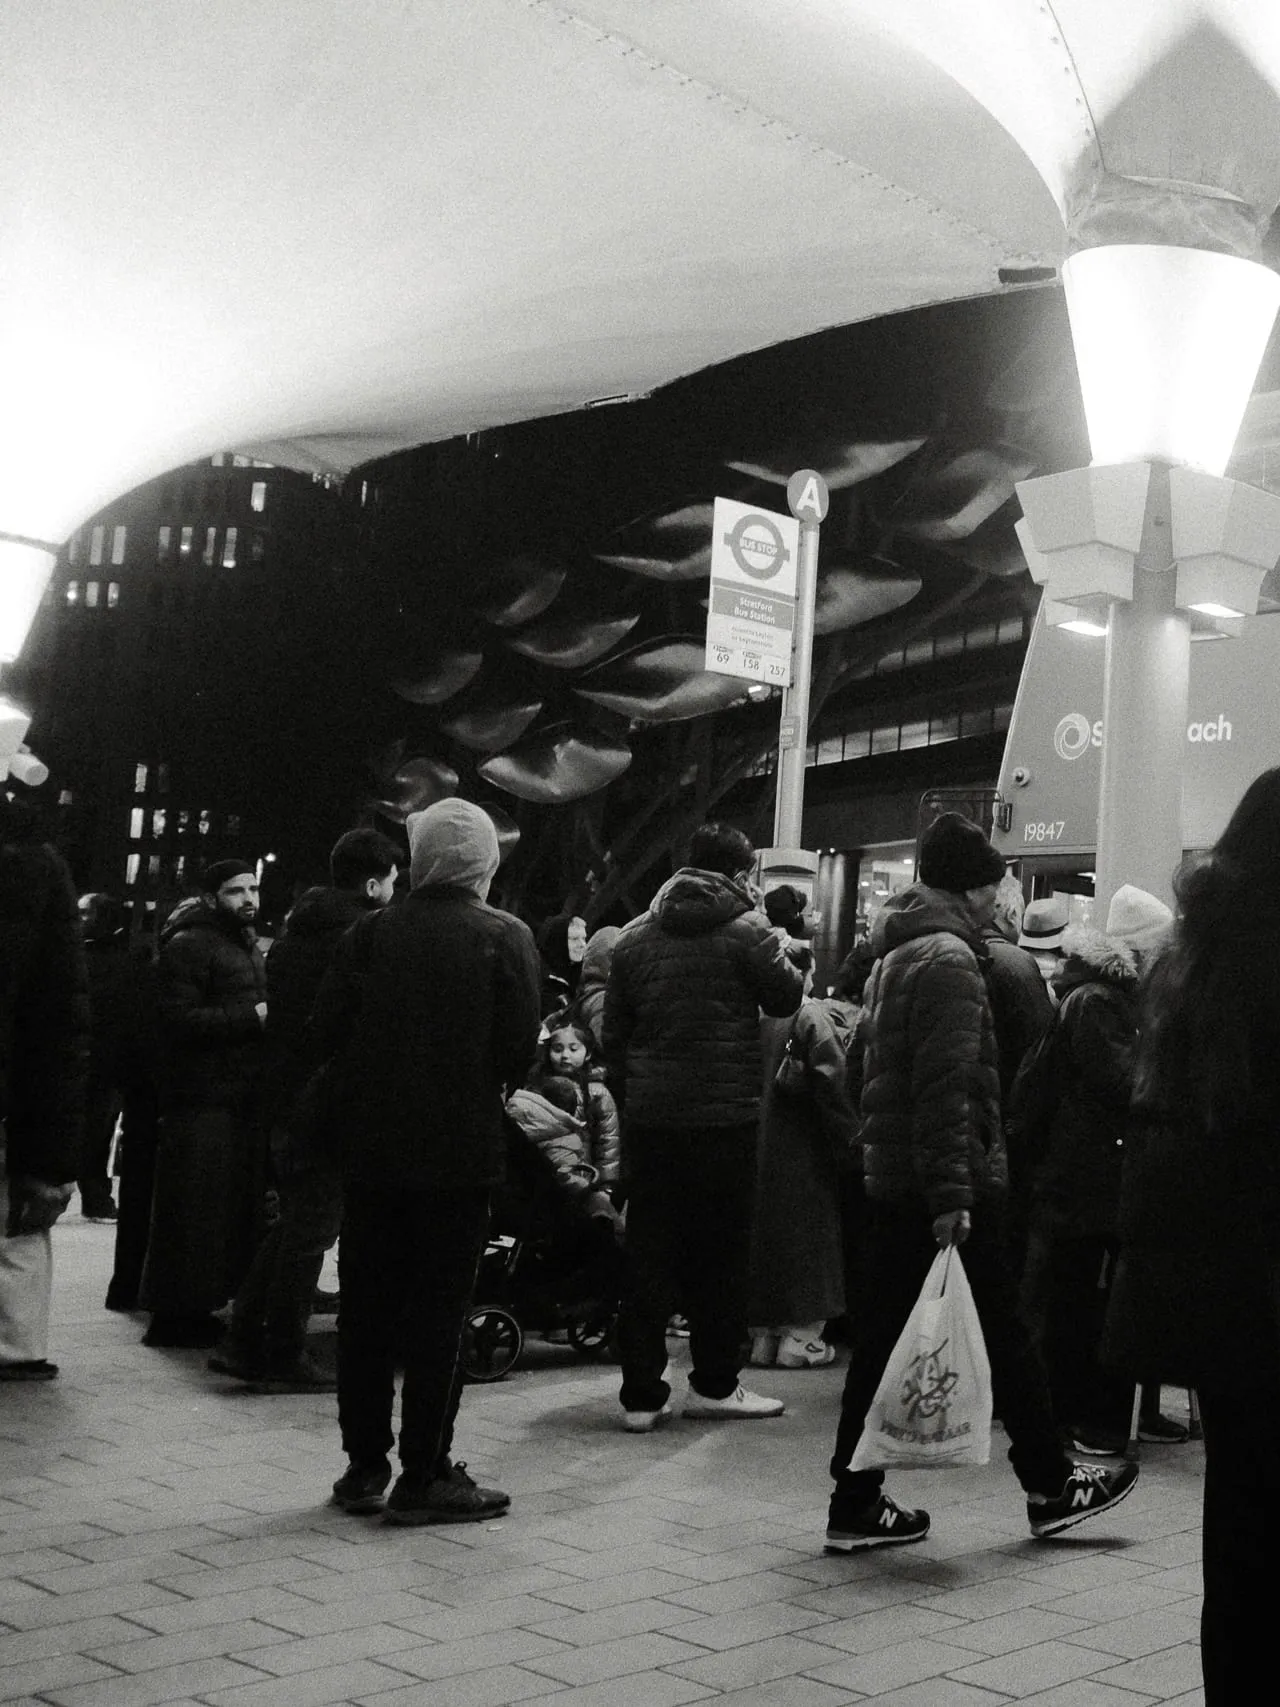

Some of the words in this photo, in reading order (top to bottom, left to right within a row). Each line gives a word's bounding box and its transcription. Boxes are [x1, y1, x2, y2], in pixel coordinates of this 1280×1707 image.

[796, 476, 822, 518] A
[740, 537, 756, 551] BUS
[756, 541, 778, 556] STOP
[734, 604, 749, 618] Bus
[750, 609, 776, 624] Station
[740, 597, 773, 613] Stratford
[716, 652, 730, 665] 69
[743, 658, 760, 671] 158
[769, 664, 786, 677] 257
[1023, 821, 1066, 842] 19847
[1071, 1487, 1095, 1508] N
[878, 1507, 898, 1529] N
